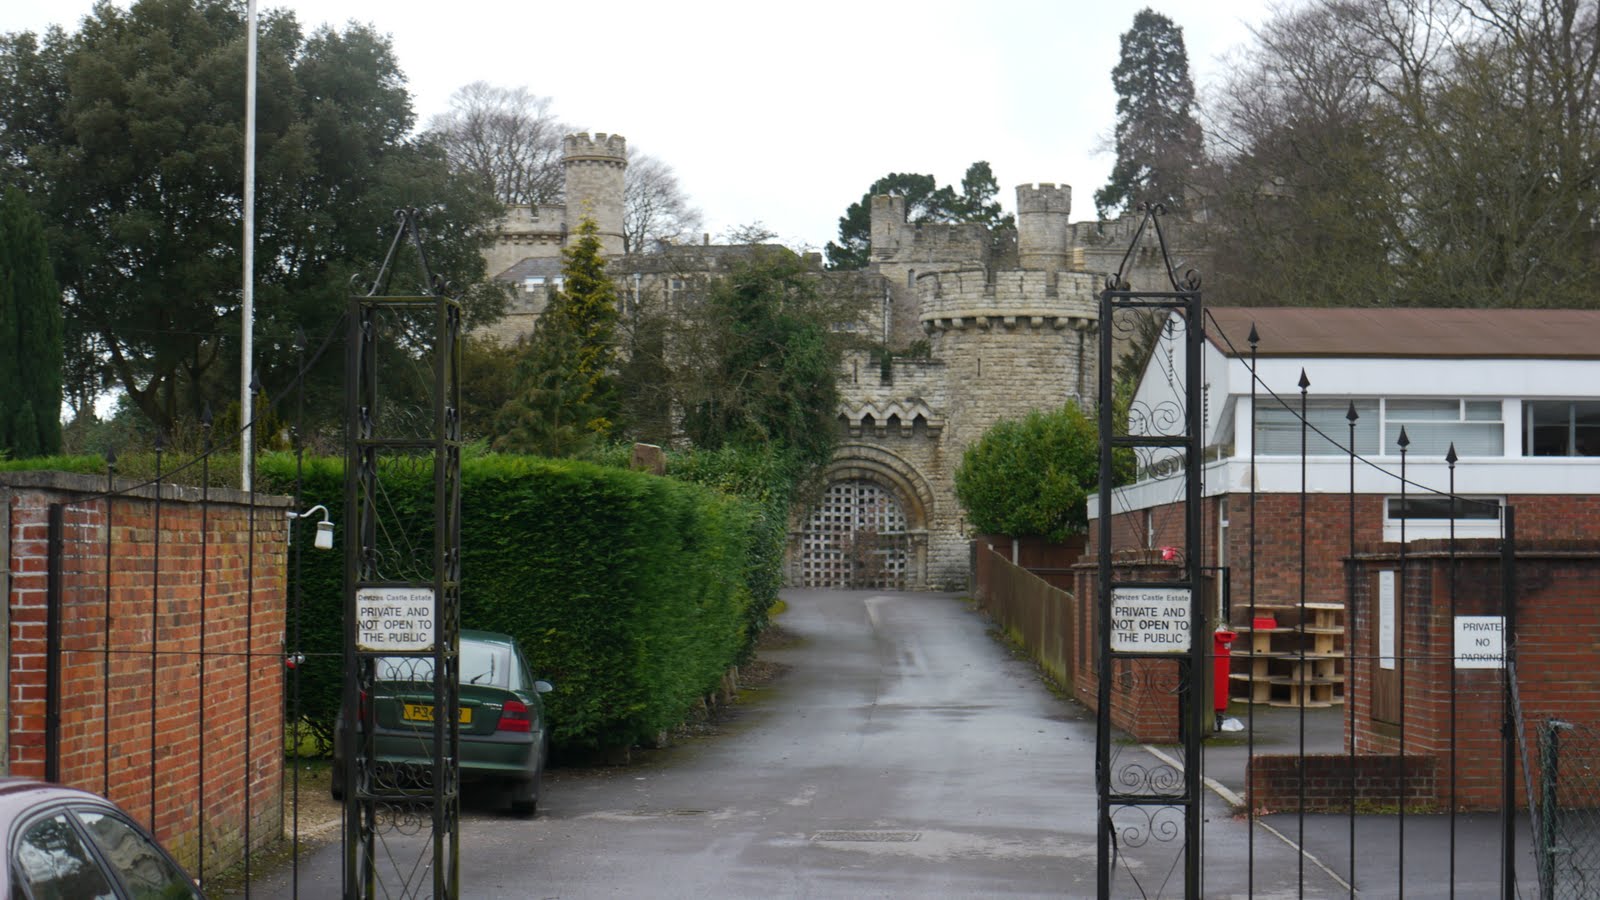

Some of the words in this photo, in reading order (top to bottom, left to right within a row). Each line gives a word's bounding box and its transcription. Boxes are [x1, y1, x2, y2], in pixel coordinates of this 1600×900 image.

[1113, 593, 1139, 601] Devizes
[1166, 594, 1189, 602] Estate
[360, 607, 402, 617] PRIVATE
[406, 607, 430, 617] AND
[1115, 606, 1158, 617] PRIVATE
[1162, 607, 1186, 617] AND
[358, 620, 379, 630] NOT
[383, 620, 413, 630] OPEN
[417, 620, 432, 630] TO
[1111, 619, 1134, 630] NOT
[1138, 619, 1169, 630] OPEN
[1174, 620, 1190, 631] TO
[1463, 622, 1502, 631] PRIVATE
[363, 632, 384, 642] THE
[388, 632, 427, 642] PUBLIC
[1117, 632, 1139, 643] THE
[1144, 632, 1183, 643] PUBLIC
[1475, 638, 1491, 647] NO
[1461, 653, 1503, 662] PARKING
